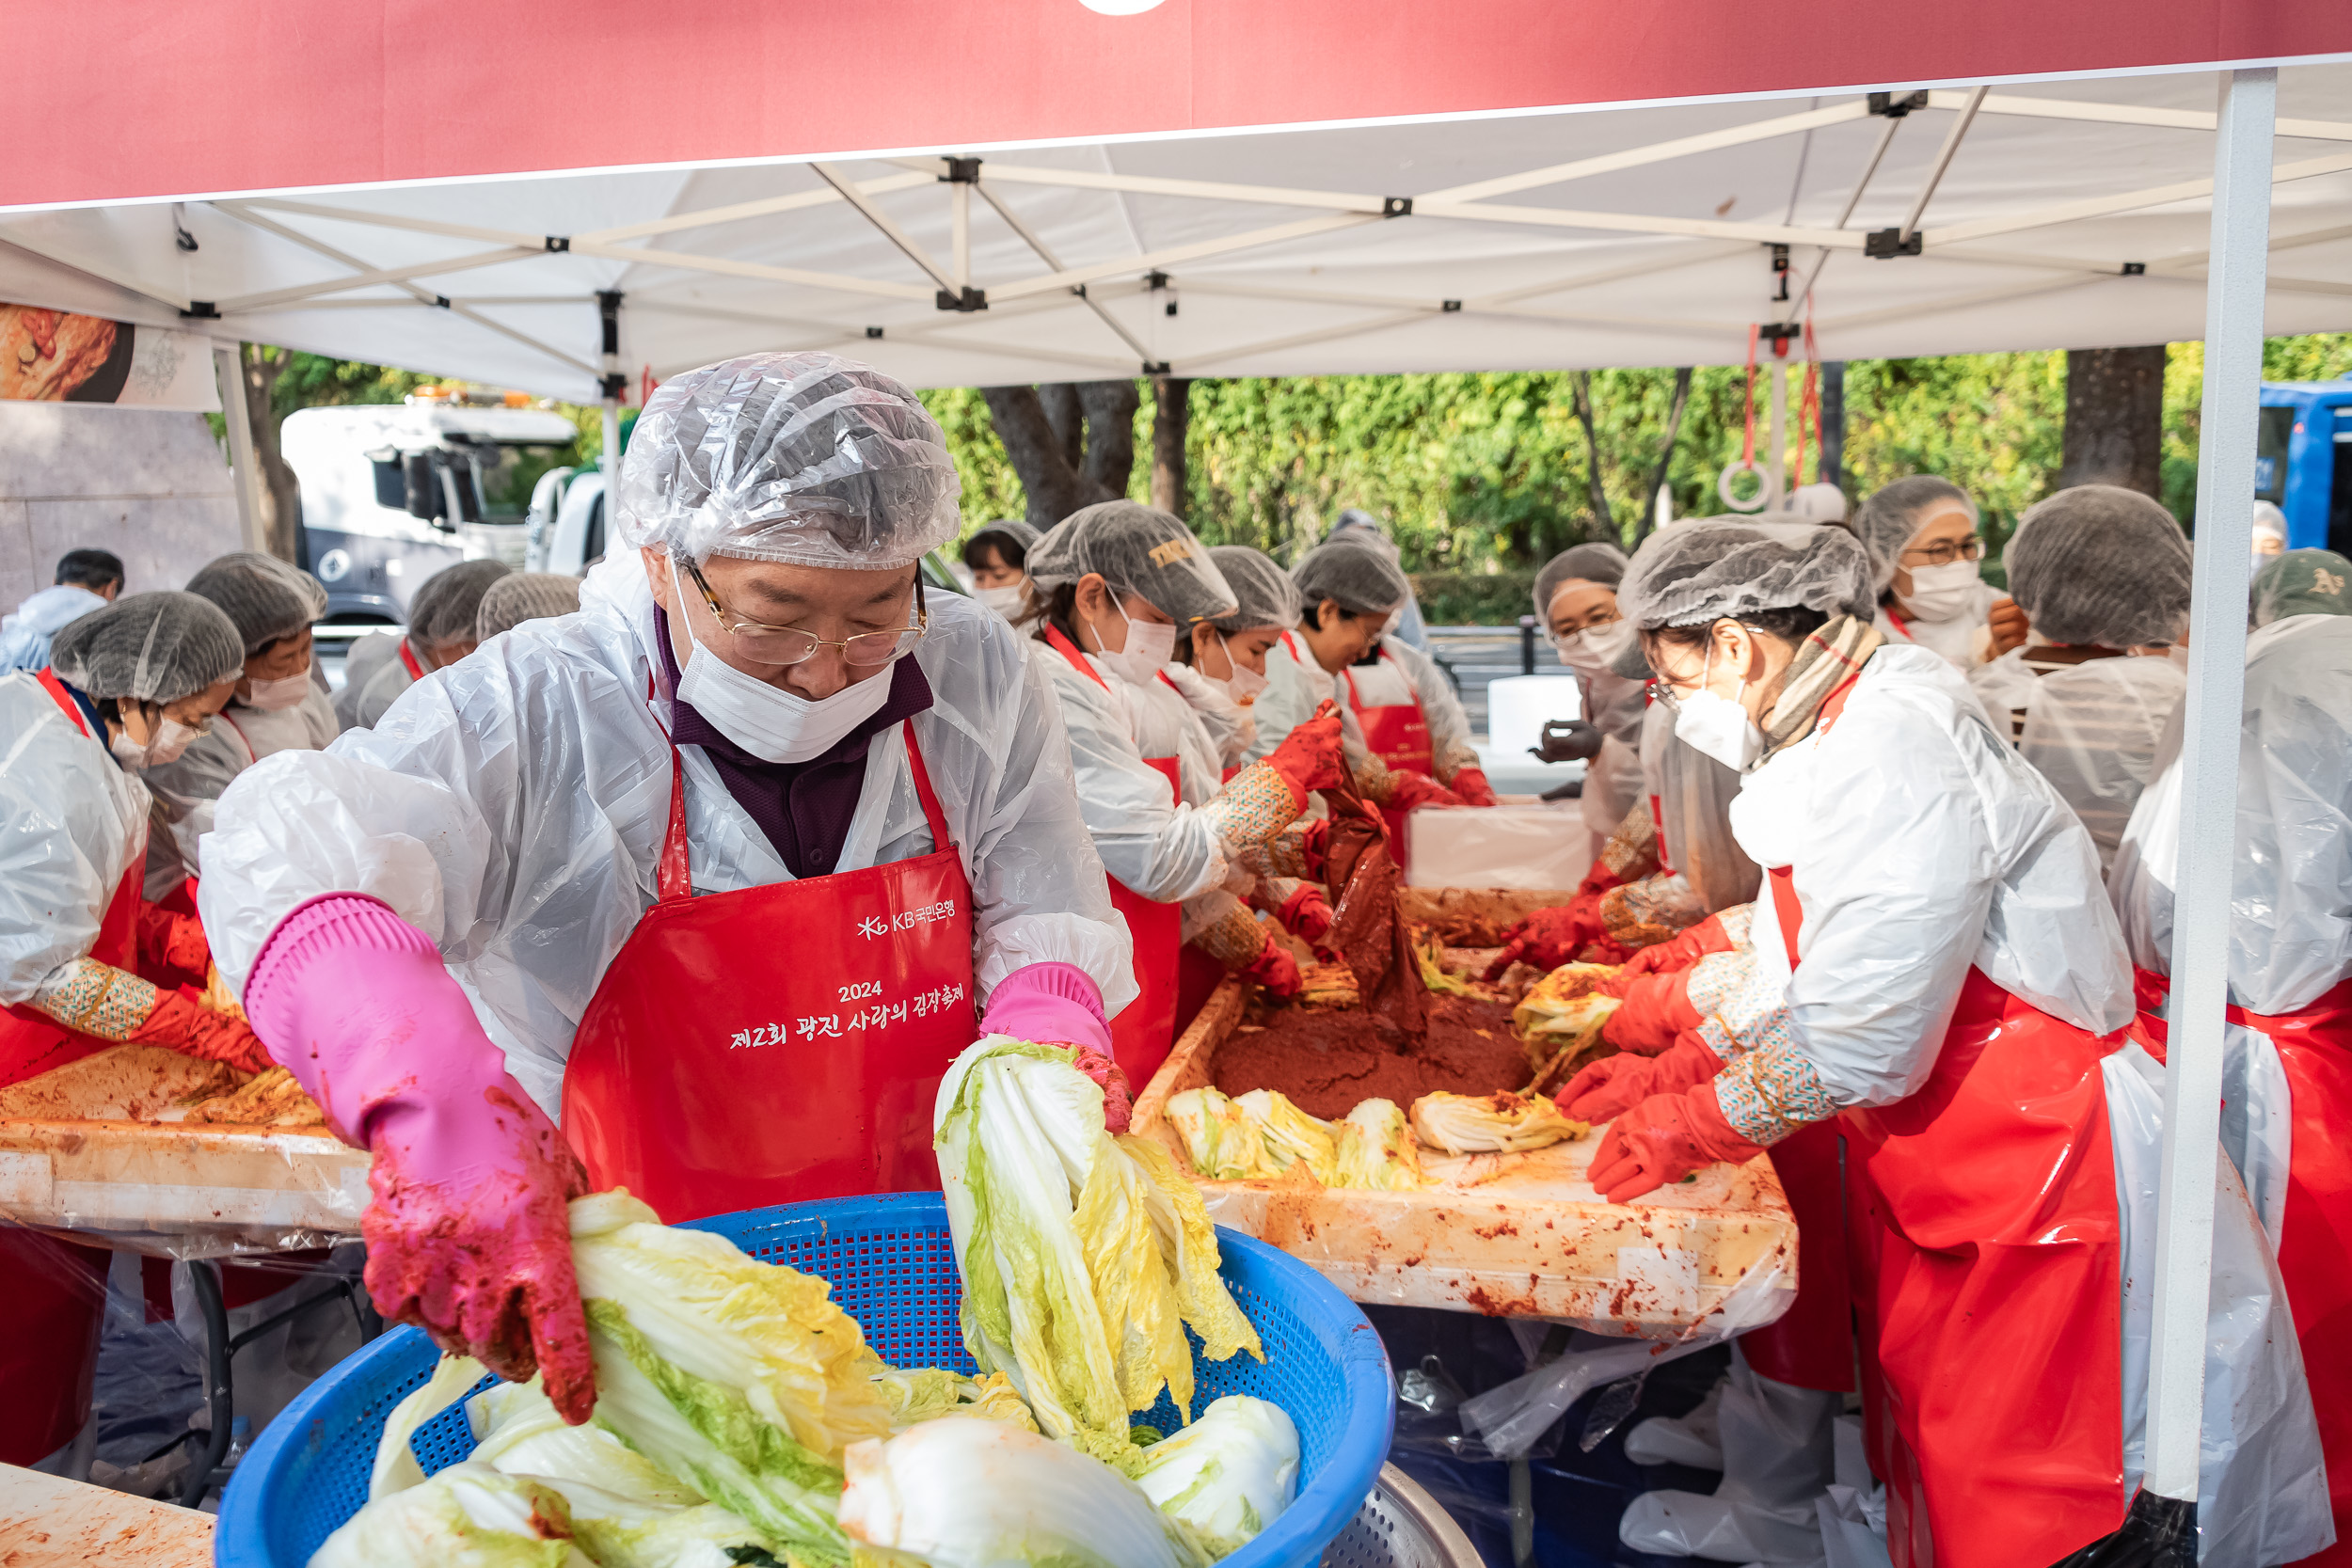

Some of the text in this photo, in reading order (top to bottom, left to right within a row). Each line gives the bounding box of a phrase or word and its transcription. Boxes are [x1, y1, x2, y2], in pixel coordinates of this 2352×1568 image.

[892, 899, 955, 931] KB국민은행
[837, 980, 882, 1003] 2024
[730, 983, 964, 1049] 제2회 광진 사랑의 김장축제
